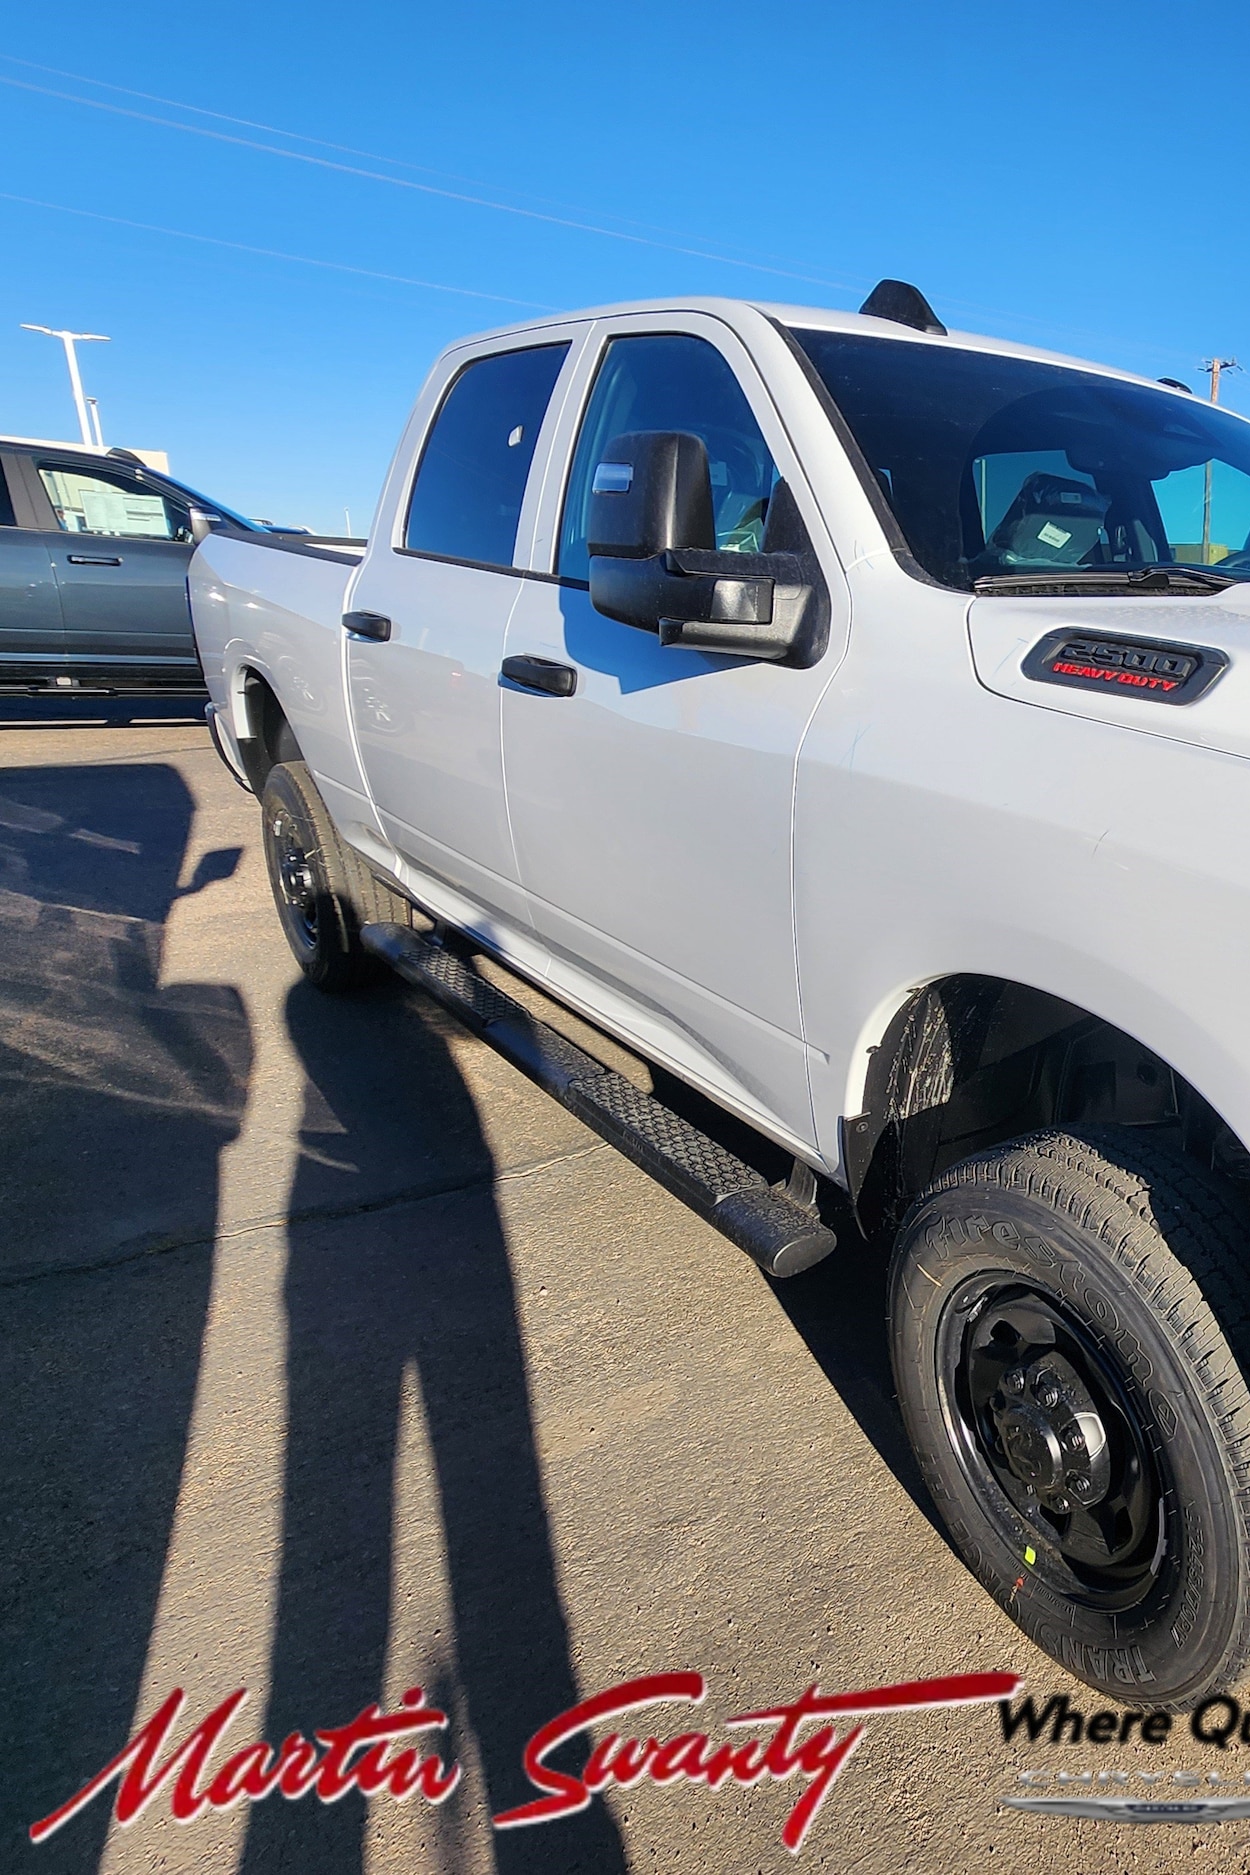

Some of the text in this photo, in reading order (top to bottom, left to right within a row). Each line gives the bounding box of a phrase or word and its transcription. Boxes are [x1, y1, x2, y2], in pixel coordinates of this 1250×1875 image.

[1053, 662, 1179, 692] HEAVY DUTY
[1060, 643, 1191, 678] 2500
[925, 1214, 1180, 1444] Firestone
